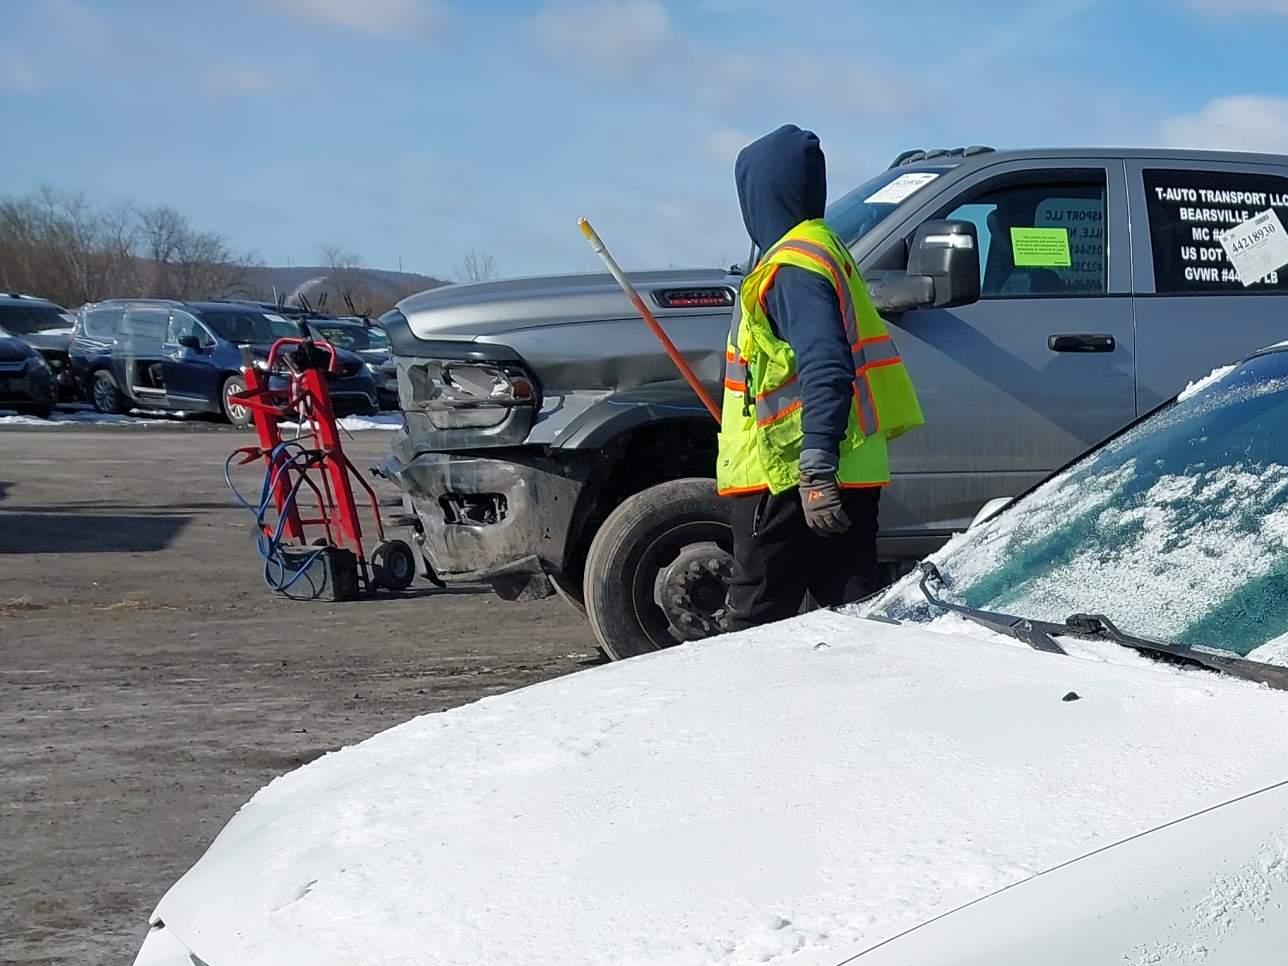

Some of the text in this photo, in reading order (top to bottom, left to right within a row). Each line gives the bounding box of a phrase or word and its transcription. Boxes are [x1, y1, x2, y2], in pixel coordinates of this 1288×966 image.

[1155, 187, 1197, 202] T-AUTO
[1198, 189, 1267, 206] TRANSPORT
[1191, 226, 1210, 241] MC
[1231, 222, 1277, 254] 44218930
[1180, 245, 1198, 260] US
[1199, 247, 1223, 262] DOT
[1184, 266, 1220, 282] GVWR
[1263, 270, 1279, 284] LB
